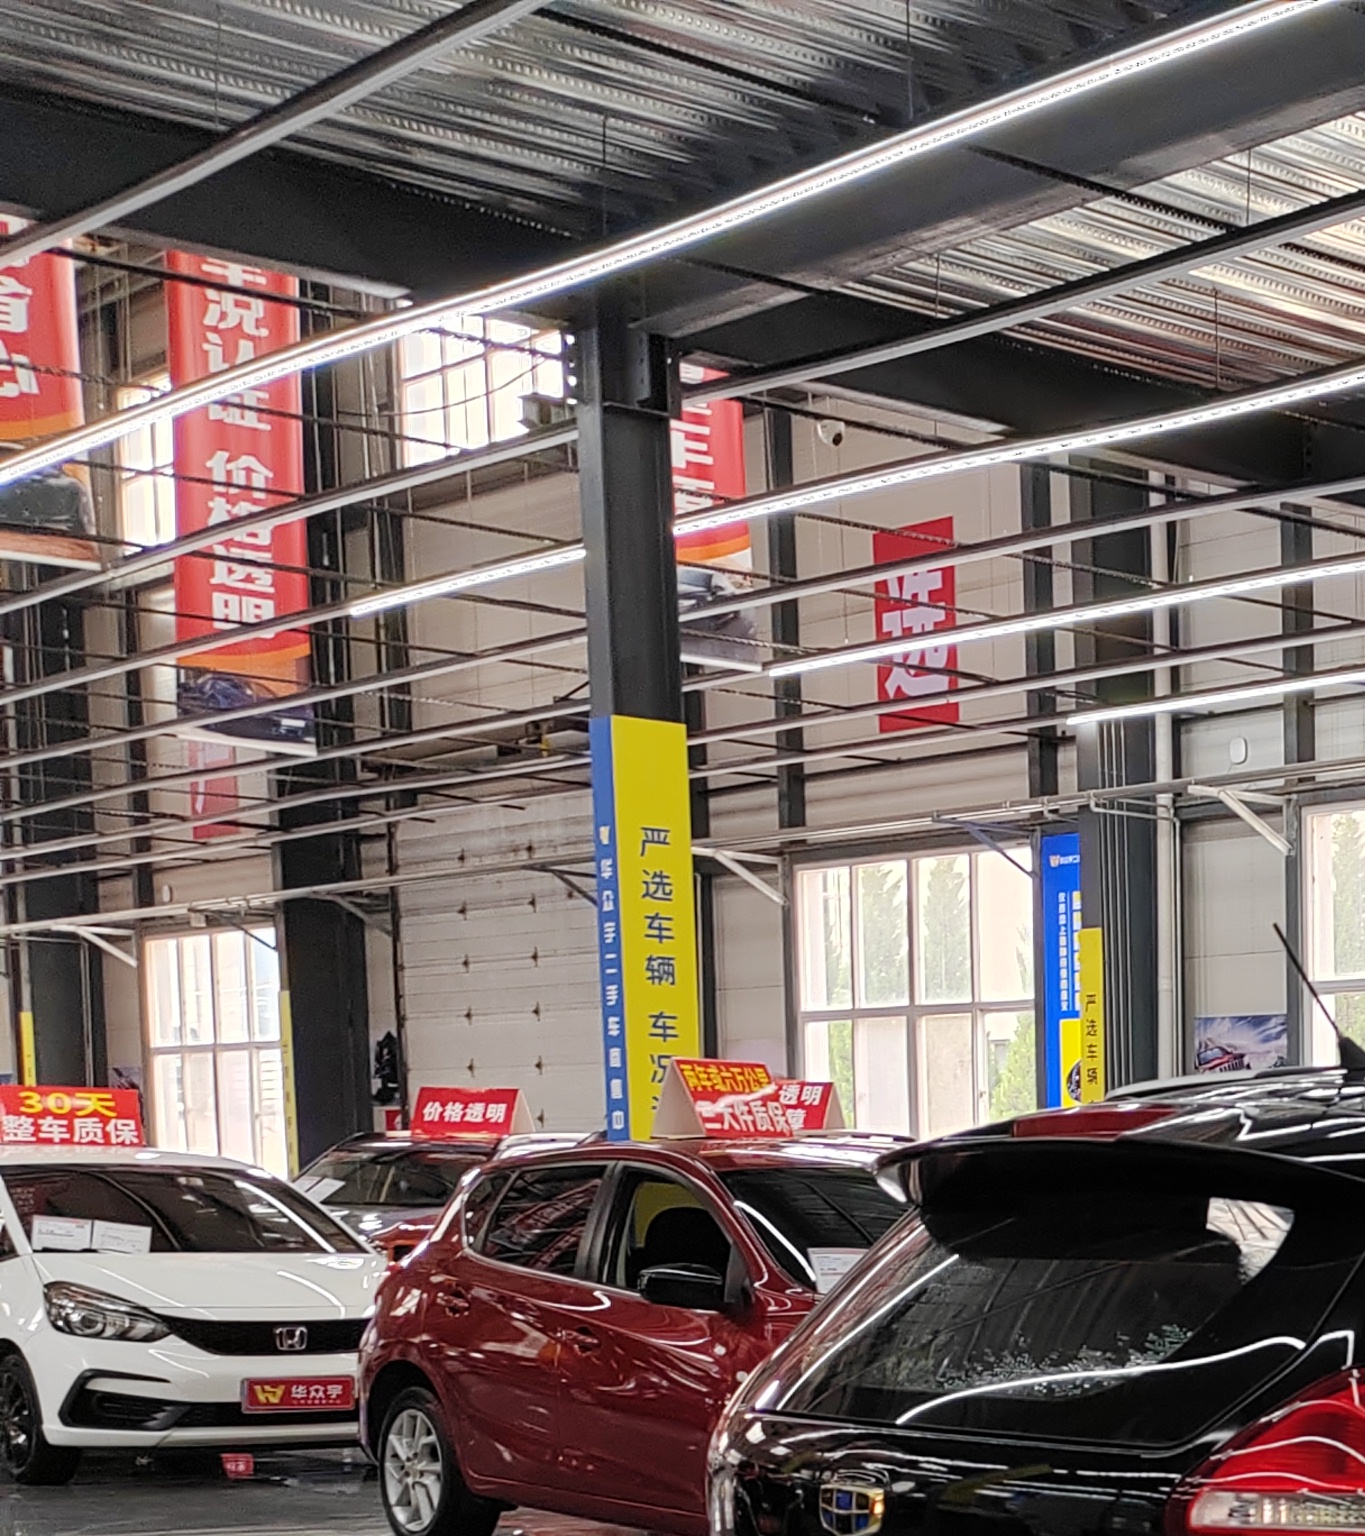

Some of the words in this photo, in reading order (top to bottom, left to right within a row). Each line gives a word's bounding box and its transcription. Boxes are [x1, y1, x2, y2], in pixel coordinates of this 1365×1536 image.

[640, 826, 677, 986] 严选车辆
[680, 1064, 770, 1093] 两年或六万公里
[18, 1091, 118, 1117] 30天
[422, 1101, 508, 1123] 价格透明
[2, 1115, 140, 1145] 整车质保
[290, 1384, 343, 1399] 华众宇
